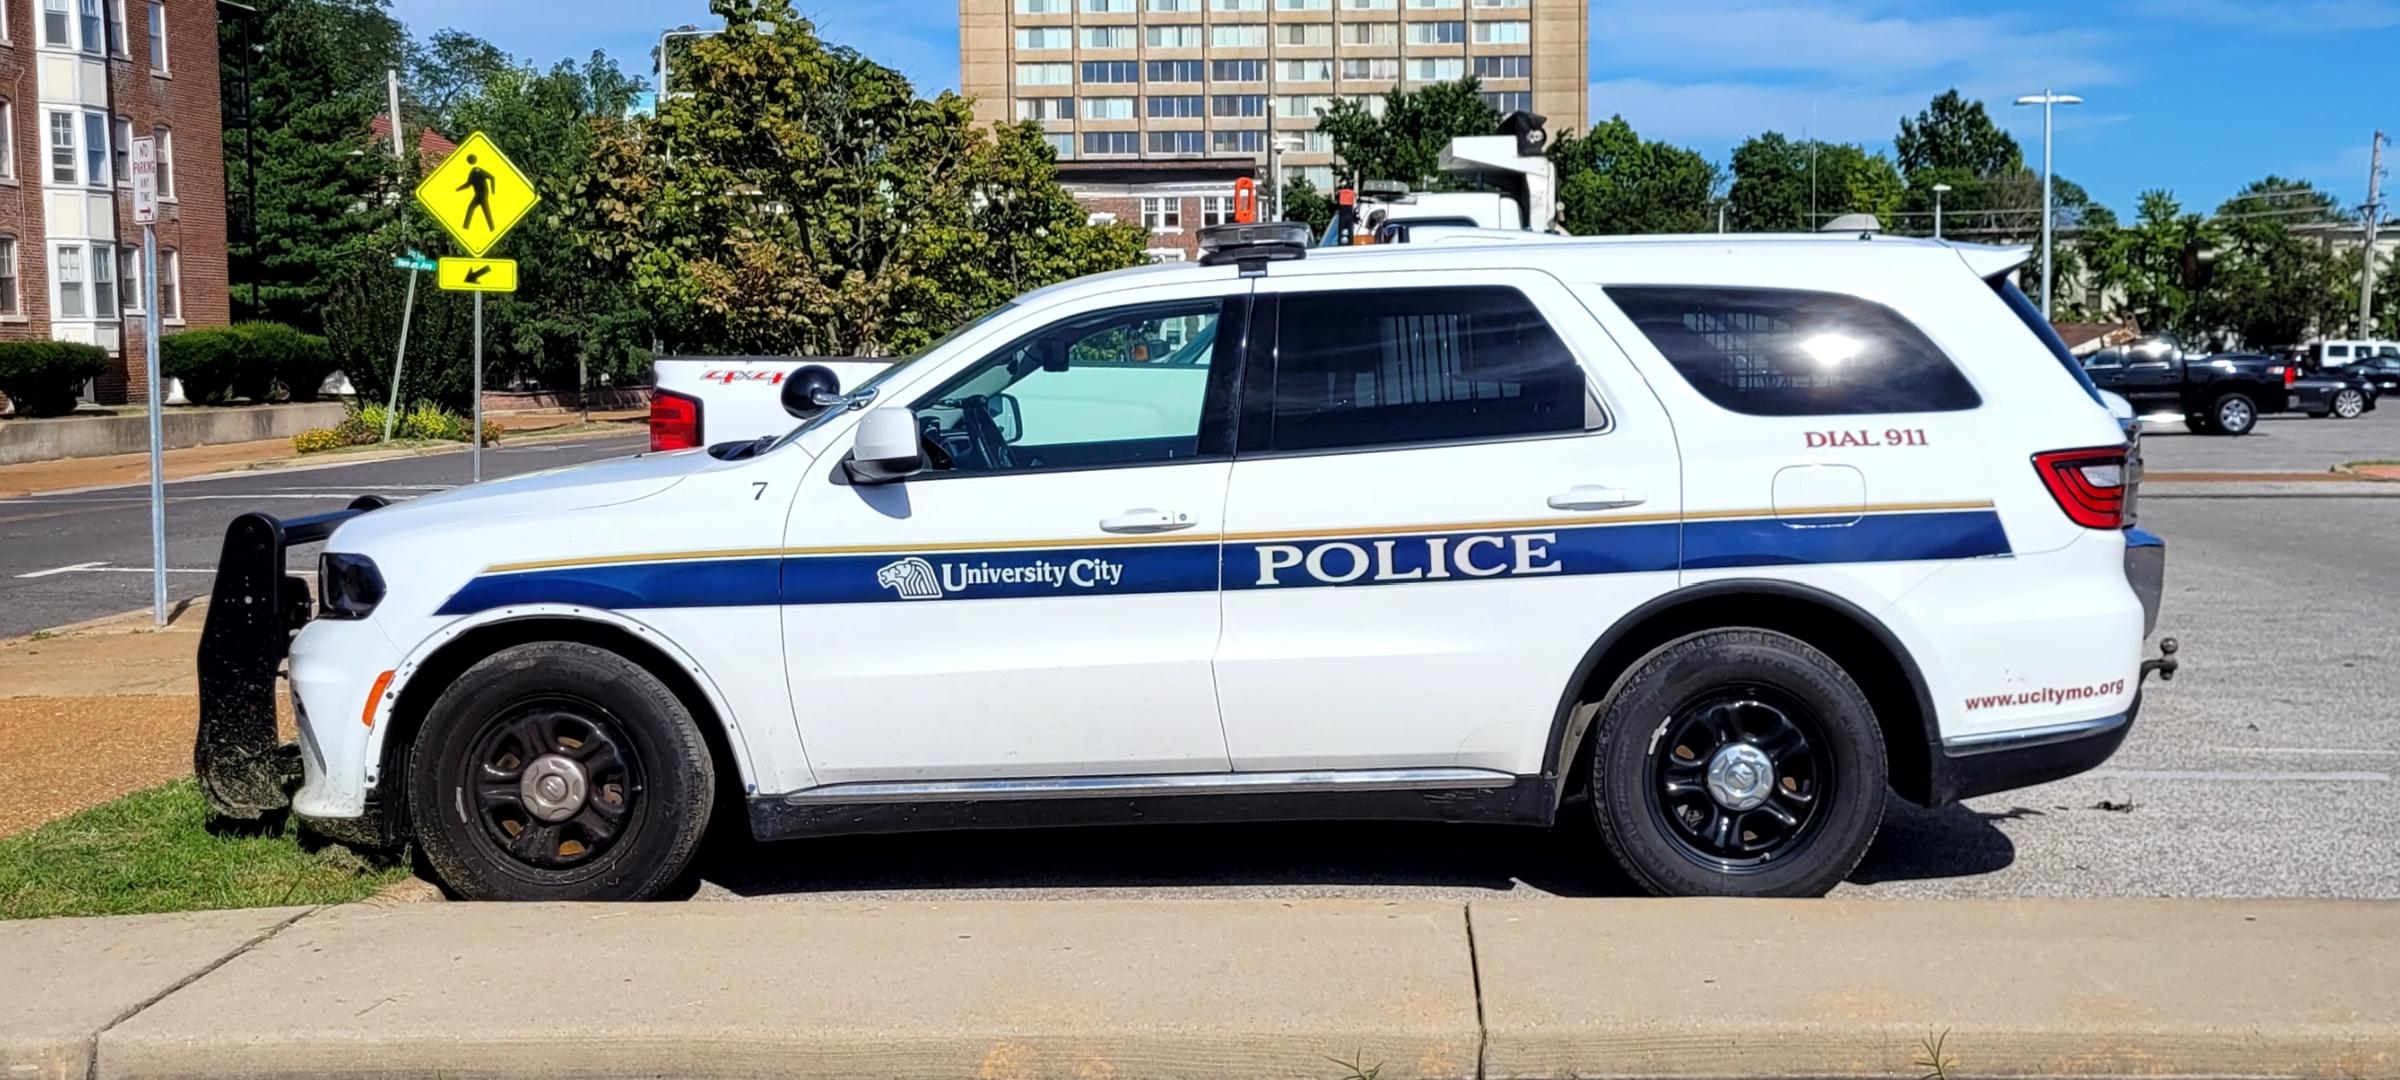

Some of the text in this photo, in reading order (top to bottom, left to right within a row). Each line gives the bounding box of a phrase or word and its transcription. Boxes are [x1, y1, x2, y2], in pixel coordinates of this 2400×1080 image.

[139, 143, 149, 158] NO
[133, 161, 155, 174] PARKING
[1803, 428, 1929, 448] DIAL 911
[752, 481, 768, 500] 7
[1254, 532, 1562, 585] POLICE
[941, 558, 1123, 592] University City
[1964, 679, 2125, 710] www.ucitymo.org
